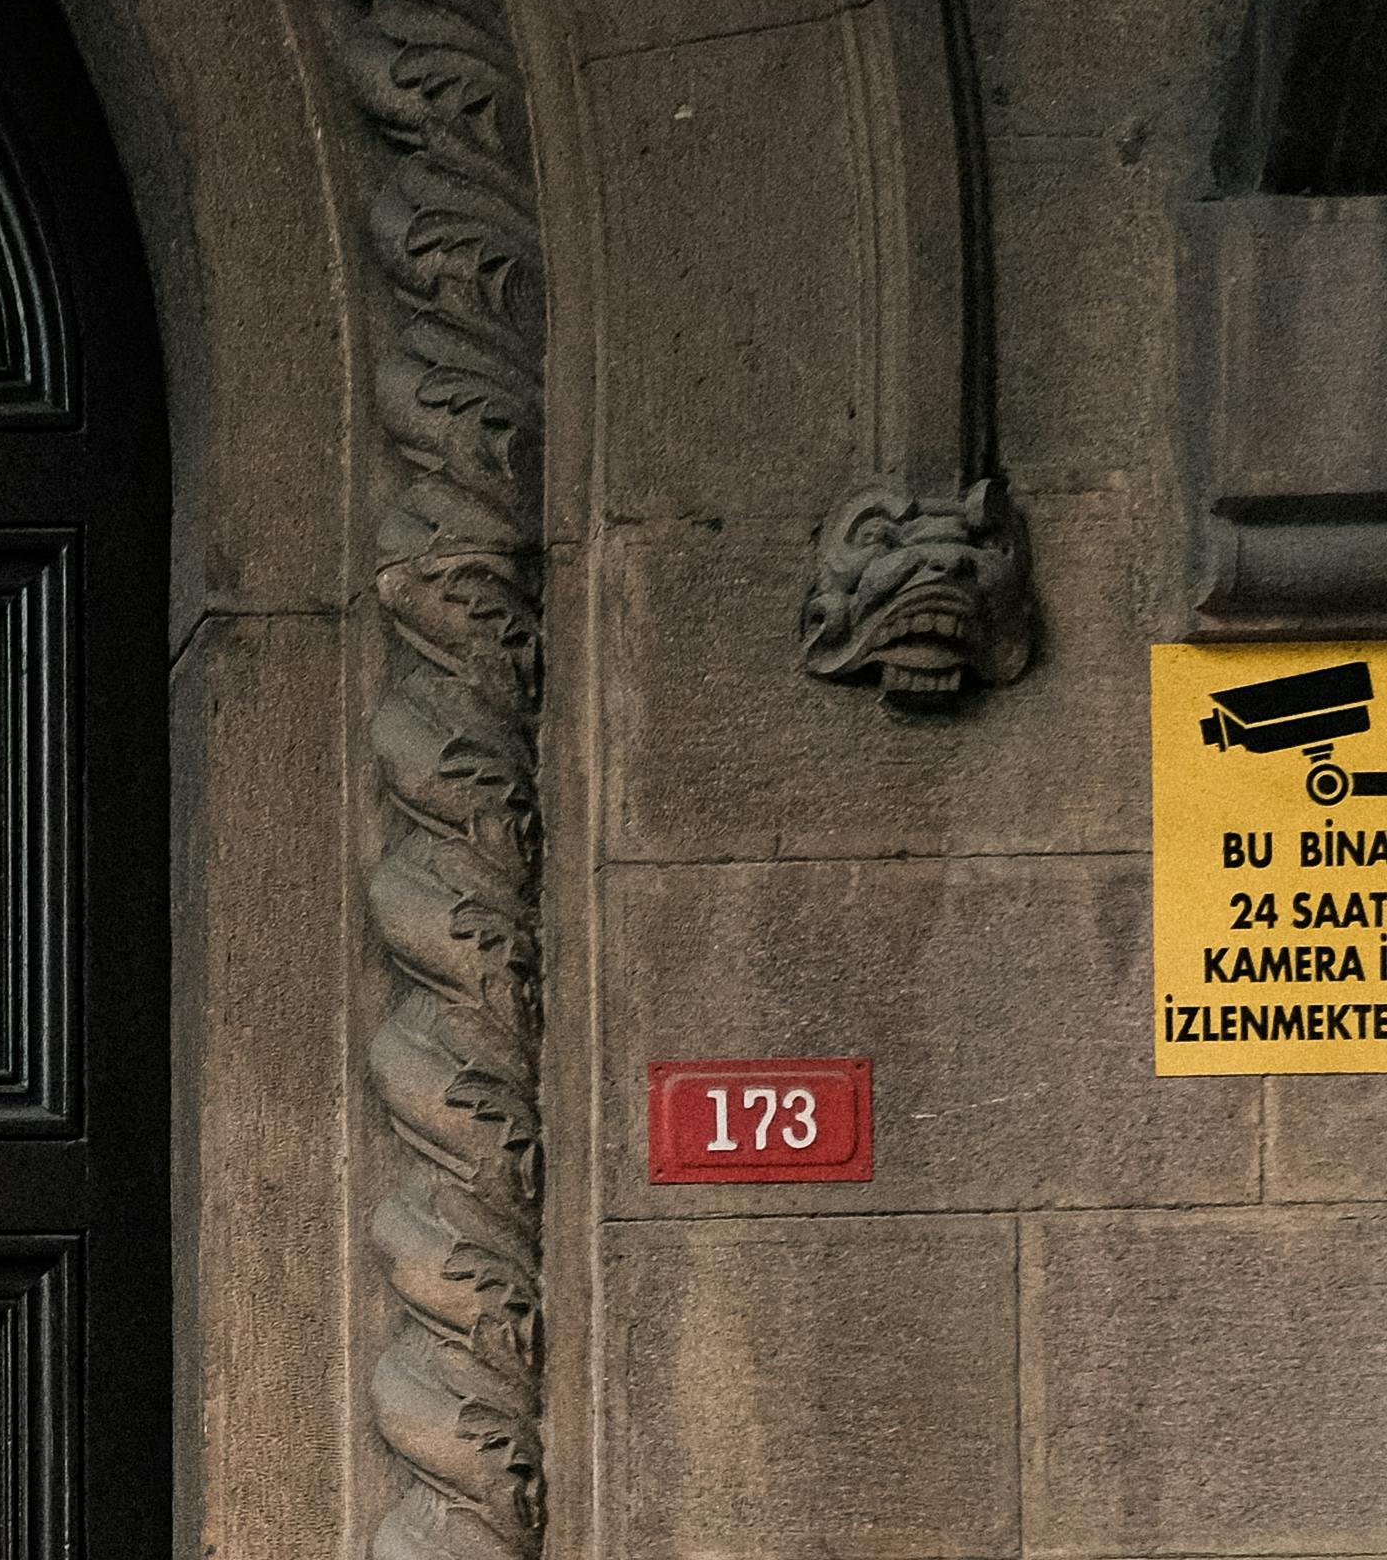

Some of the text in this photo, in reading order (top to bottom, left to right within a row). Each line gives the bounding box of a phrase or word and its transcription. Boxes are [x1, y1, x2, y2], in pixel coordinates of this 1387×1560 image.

[1223, 818, 1387, 868] BU BİNA
[1229, 892, 1387, 929] 24 SAAT
[1204, 945, 1366, 983] KAMERA
[1164, 993, 1387, 1043] İZLENMEKTE
[706, 1088, 819, 1151] 173
